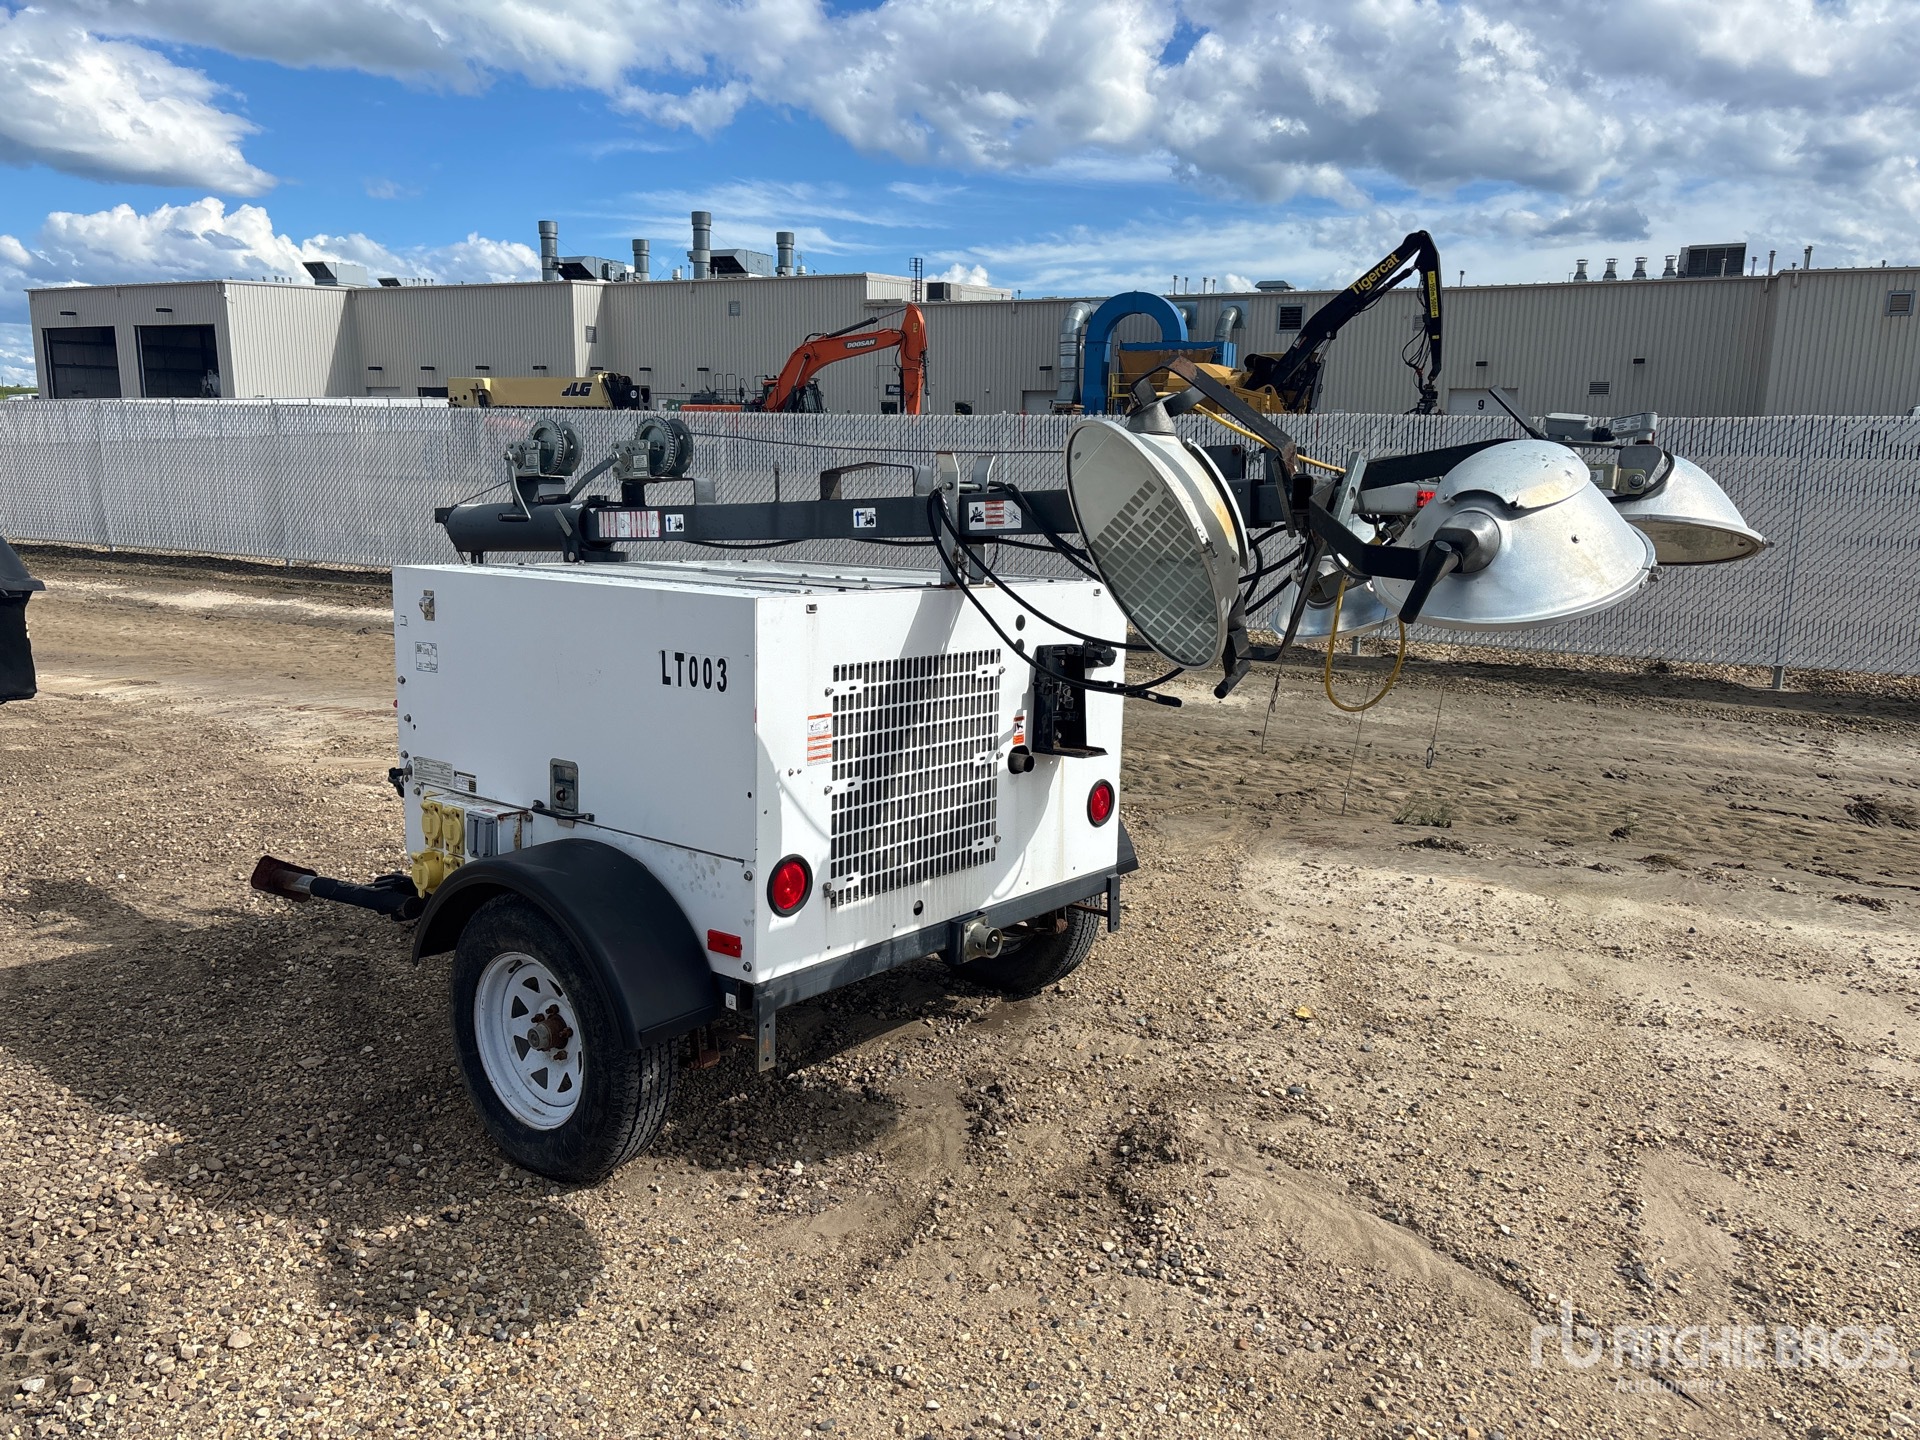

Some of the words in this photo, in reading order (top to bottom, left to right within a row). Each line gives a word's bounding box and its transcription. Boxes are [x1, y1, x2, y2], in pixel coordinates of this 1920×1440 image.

[1349, 253, 1400, 294] Tigercat
[847, 339, 875, 349] DOOSAN
[561, 382, 593, 397] JLG
[1049, 400, 1054, 409] 7
[1478, 399, 1485, 410] 9
[661, 650, 728, 692] LT003
